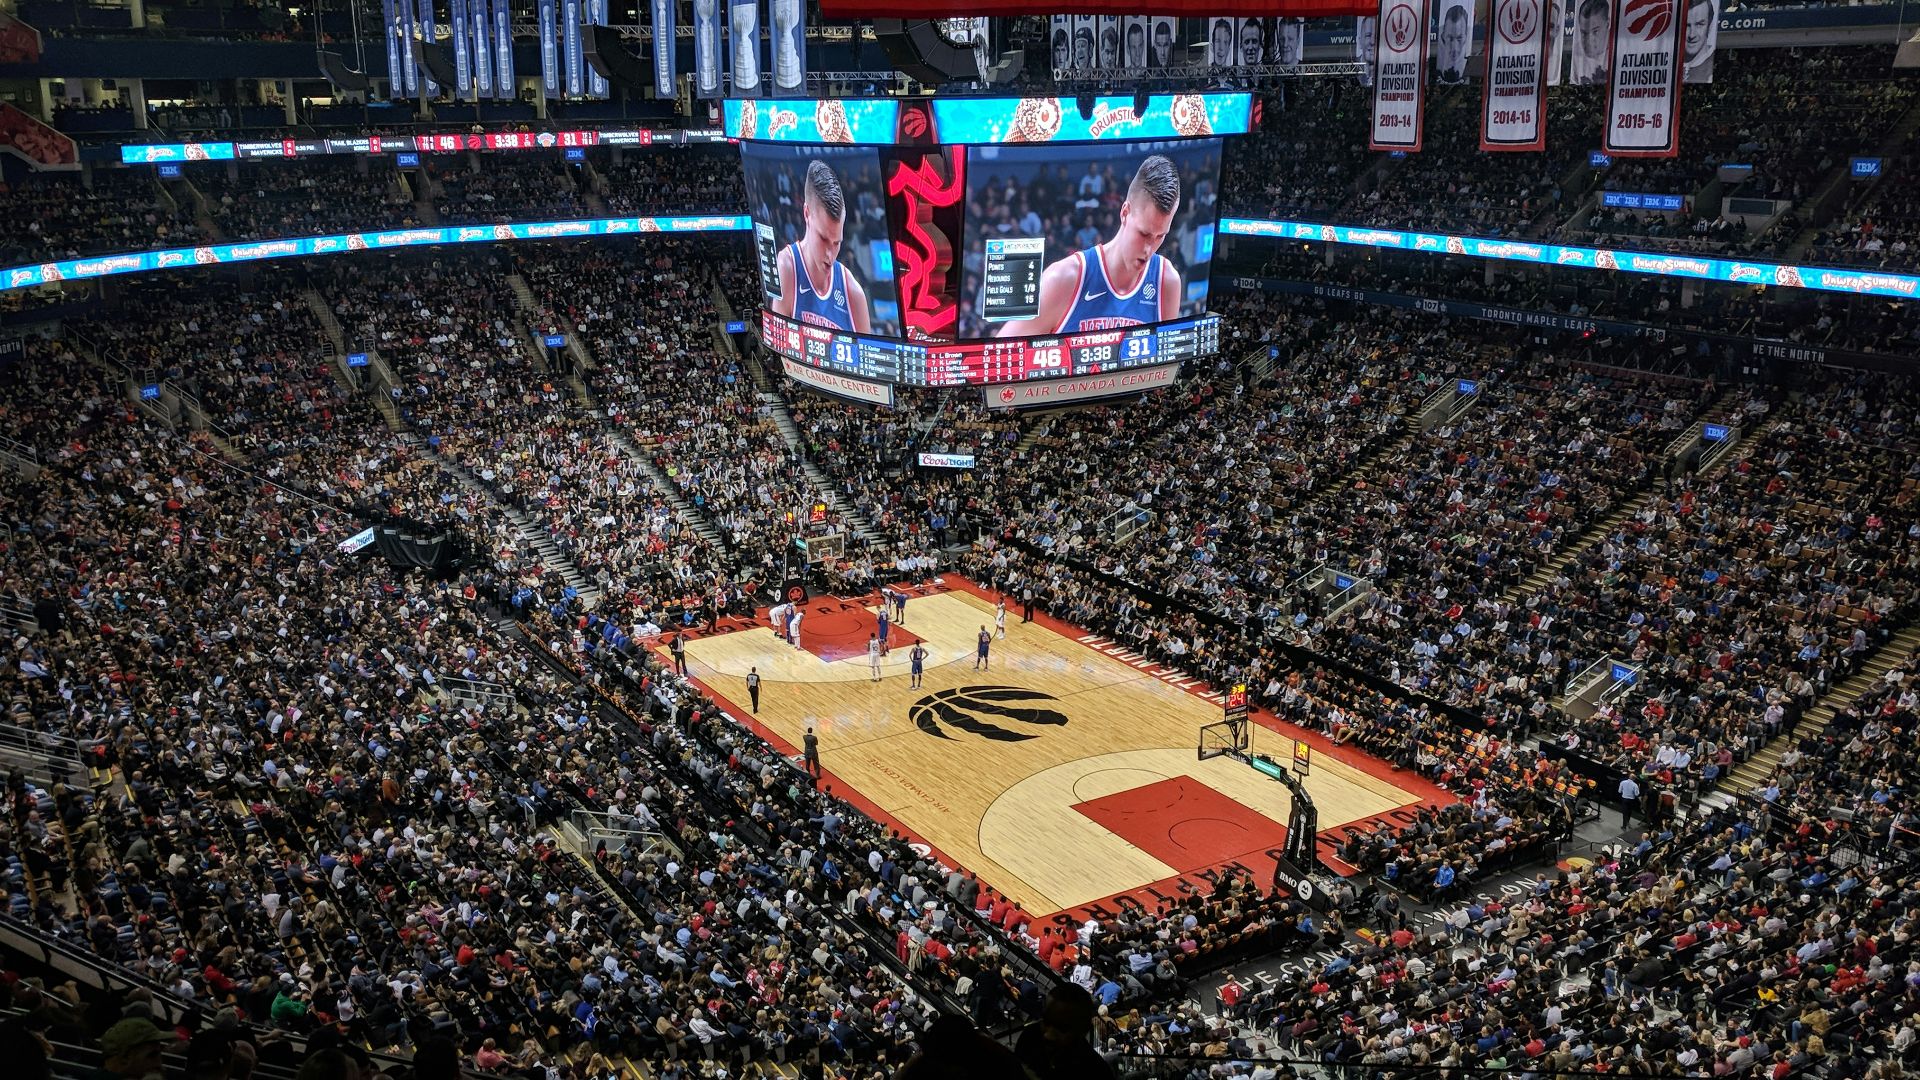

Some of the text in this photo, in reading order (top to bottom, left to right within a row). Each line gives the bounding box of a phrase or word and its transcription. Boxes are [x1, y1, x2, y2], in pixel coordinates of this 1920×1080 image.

[1621, 52, 1668, 68] ATLANTIC
[1382, 77, 1416, 91] DIVISION
[1494, 70, 1534, 85] DIVISION
[1620, 68, 1668, 86] DIVISION
[1494, 86, 1534, 97] CHAMPIONS
[1618, 86, 1666, 99] CHAMPIONS
[1380, 114, 1412, 128] 2013-14
[1493, 110, 1531, 125] 2014-15
[1617, 114, 1662, 129] 2015-16
[440, 136, 454, 150] 46
[494, 134, 518, 148] 3:38
[564, 132, 577, 146] 31
[161, 165, 178, 174] IBM
[1856, 162, 1877, 172] IBM
[1606, 195, 1620, 204] IBM
[1625, 196, 1639, 205] IBM
[1645, 198, 1659, 206] IBM
[1664, 198, 1680, 207] IBM
[1028, 261, 1034, 270] 4
[1028, 272, 1034, 280] 2
[1241, 278, 1254, 288] 106
[1025, 295, 1034, 303] 15
[1314, 286, 1364, 300] GO LEAFS GO
[1424, 300, 1438, 311] 107
[1482, 308, 1596, 332] TORONTO MAPLE LEAFS
[1086, 332, 1121, 344] TISSOT
[1133, 329, 1150, 337] KNICKS
[788, 331, 800, 350] 46
[1032, 340, 1059, 348] RAPTORS
[1129, 338, 1150, 357] 31
[808, 340, 826, 356] 3:38
[836, 343, 853, 363] 31
[1081, 346, 1111, 362] 3:38
[1768, 346, 1786, 358] THE
[1789, 348, 1826, 362] NORTH
[350, 356, 364, 364] IBM
[1033, 348, 1062, 368] 46
[1077, 366, 1086, 374] 24
[794, 365, 880, 396] AIR CANADA CENTRE
[1025, 370, 1168, 398] AIR CANADA CENTRE
[922, 455, 973, 466] Coors LIGHT
[813, 512, 825, 520] 24
[1150, 668, 1202, 690] THE
[1230, 694, 1244, 707] 24
[868, 758, 951, 813] AIR CANADA CENTRE
[1280, 871, 1297, 888] BMO
